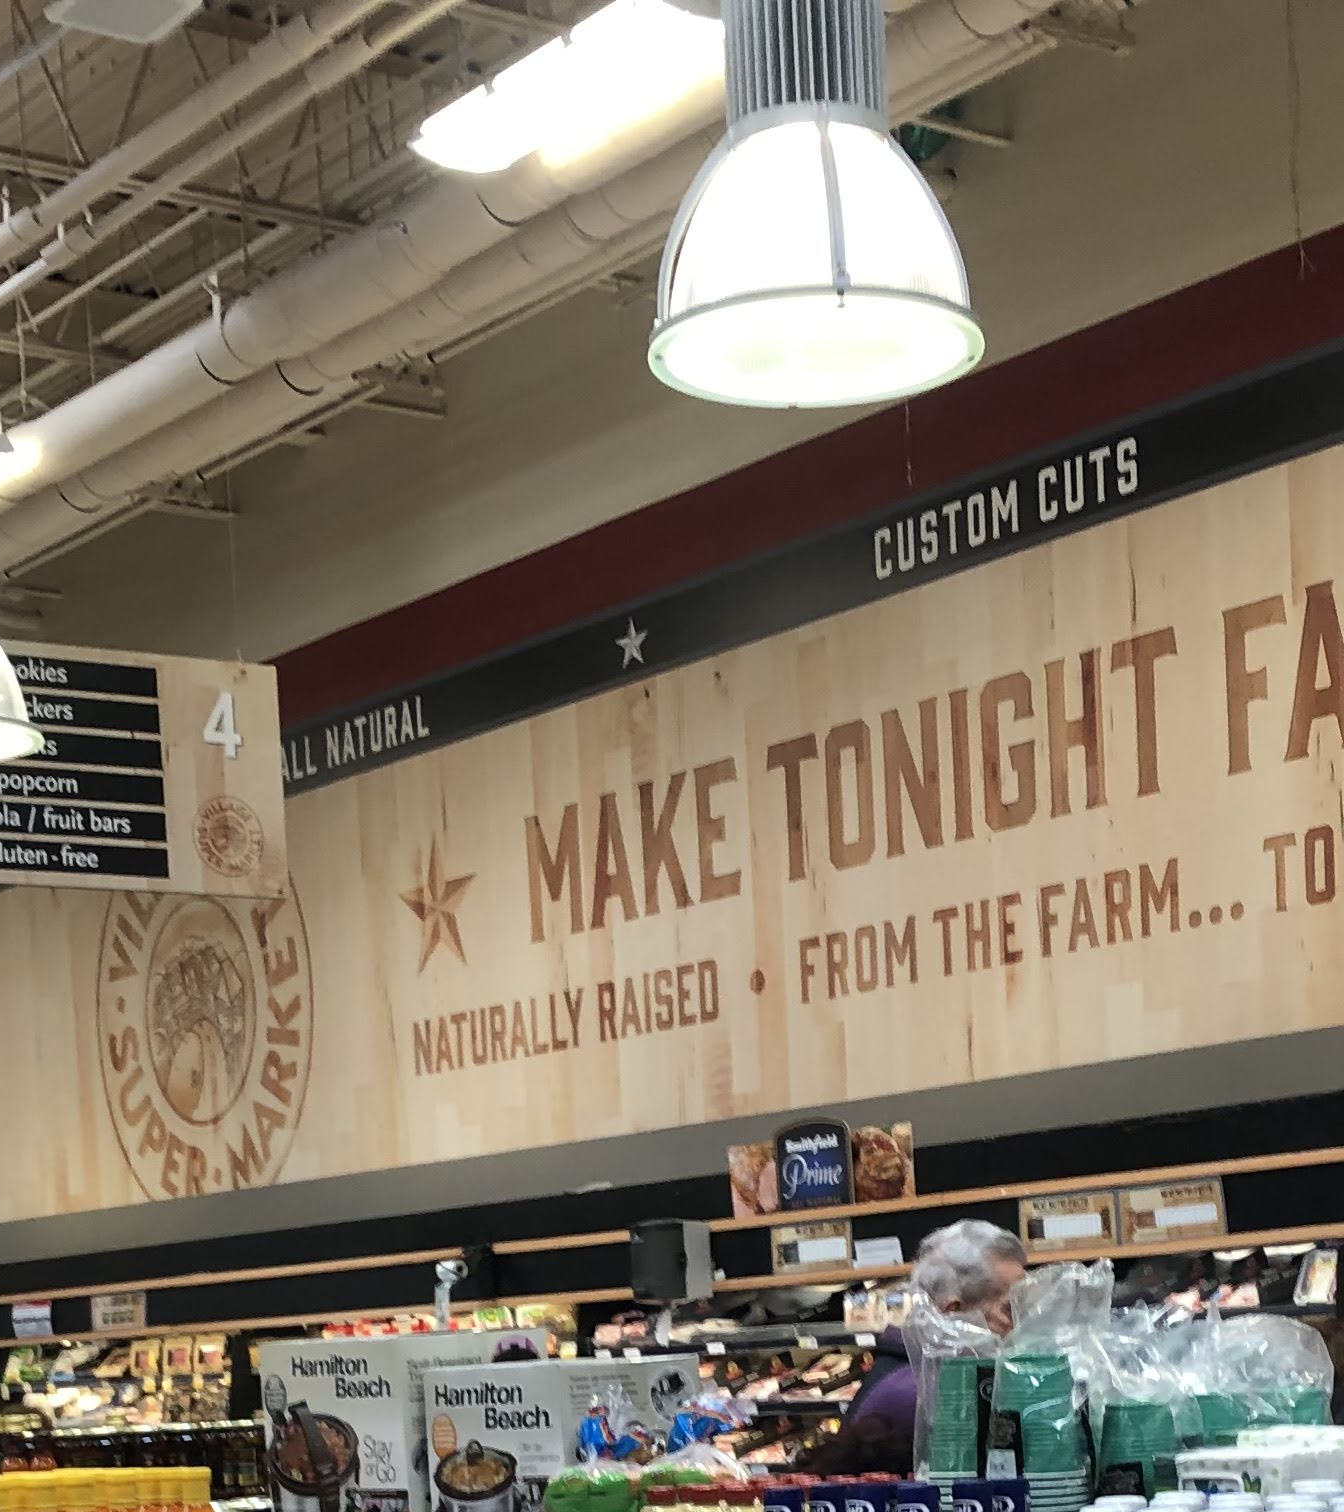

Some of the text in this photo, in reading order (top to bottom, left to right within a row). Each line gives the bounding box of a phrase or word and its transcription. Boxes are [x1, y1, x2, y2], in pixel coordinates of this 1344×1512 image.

[873, 436, 1139, 581] CUSTOM CUTS
[203, 691, 242, 760] 4
[281, 695, 430, 782] ALL NATURAL
[43, 807, 83, 830] fruit
[90, 810, 131, 834] bars
[524, 755, 742, 945] MAKE
[766, 624, 1178, 882] TONIGHT
[799, 915, 919, 1003] FROM
[932, 891, 1020, 978] THE
[1038, 857, 1245, 959] FARM...
[1262, 824, 1336, 913] TO
[229, 897, 308, 1191] MARKET
[412, 959, 720, 1076] NATURALLY RAISED
[108, 1031, 207, 1198] SUPER
[782, 1153, 843, 1200] Prime
[291, 1354, 369, 1378] Hamilton
[335, 1375, 391, 1399] Beach
[434, 1382, 523, 1408] Hamilton
[485, 1404, 551, 1430] Beach
